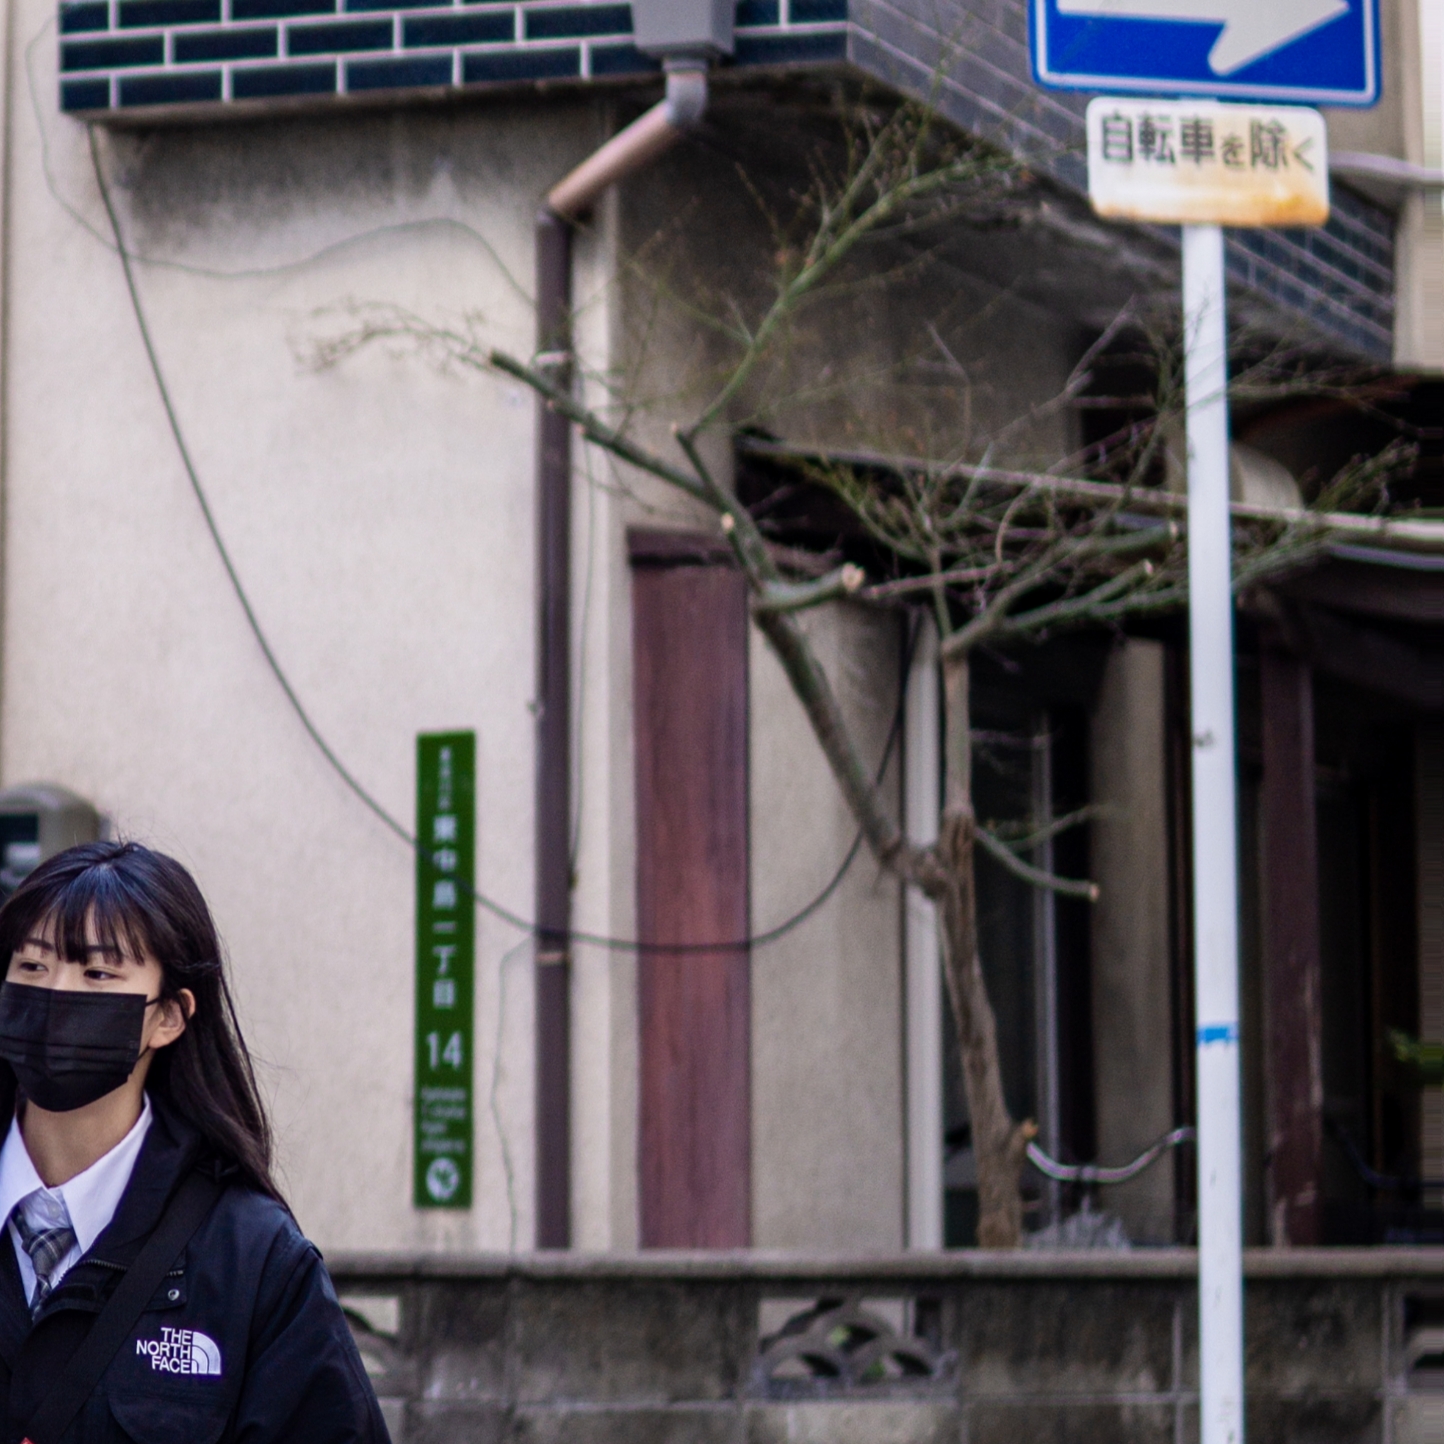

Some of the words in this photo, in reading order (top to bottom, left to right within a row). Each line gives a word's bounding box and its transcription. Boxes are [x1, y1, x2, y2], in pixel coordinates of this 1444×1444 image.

[1102, 109, 1315, 171] 自転車を除く
[426, 1030, 463, 1070] 14
[160, 1326, 192, 1346] THE
[136, 1339, 191, 1360] NORTH
[151, 1355, 191, 1374] FACE
